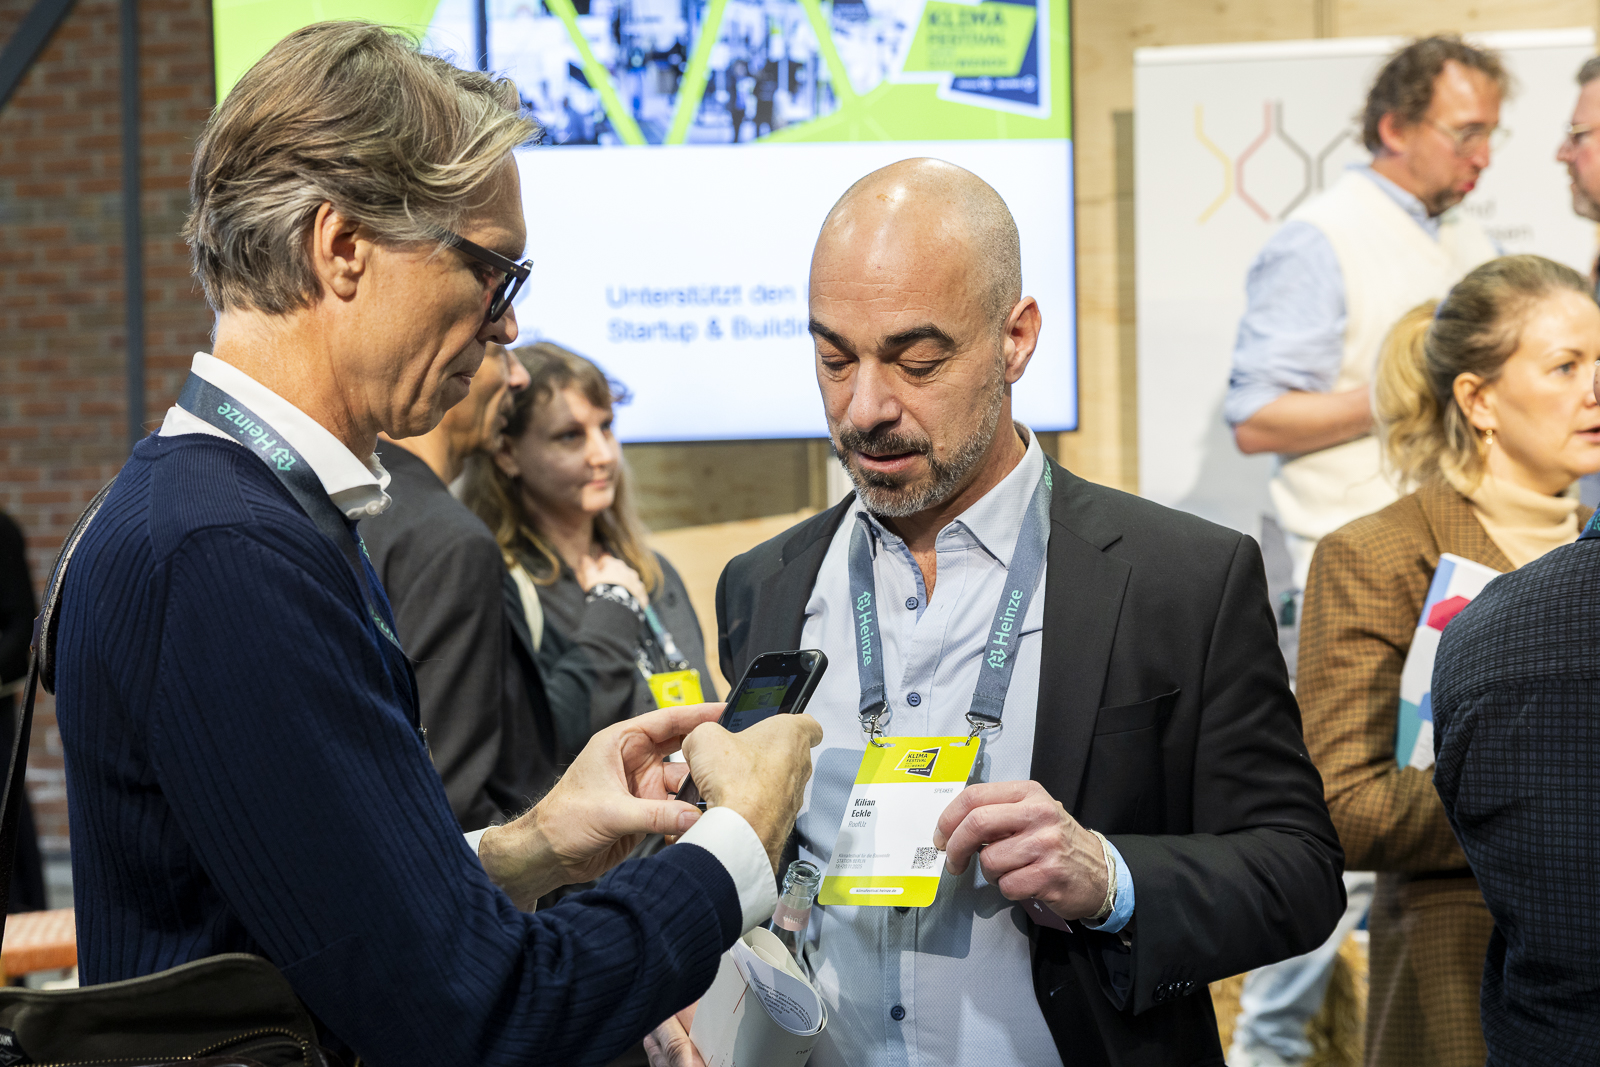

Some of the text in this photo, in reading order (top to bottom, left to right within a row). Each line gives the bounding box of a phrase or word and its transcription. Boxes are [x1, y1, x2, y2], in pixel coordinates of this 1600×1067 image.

[606, 283, 796, 309] Unterstützt den
[608, 317, 699, 343] Startup
[705, 316, 723, 340] &
[217, 401, 277, 451] Heinze
[992, 589, 1024, 646] Heinze
[858, 610, 873, 667] Heinze
[851, 809, 872, 818] Eckle
[854, 798, 876, 807] Kilian
[783, 915, 803, 924] ohne
